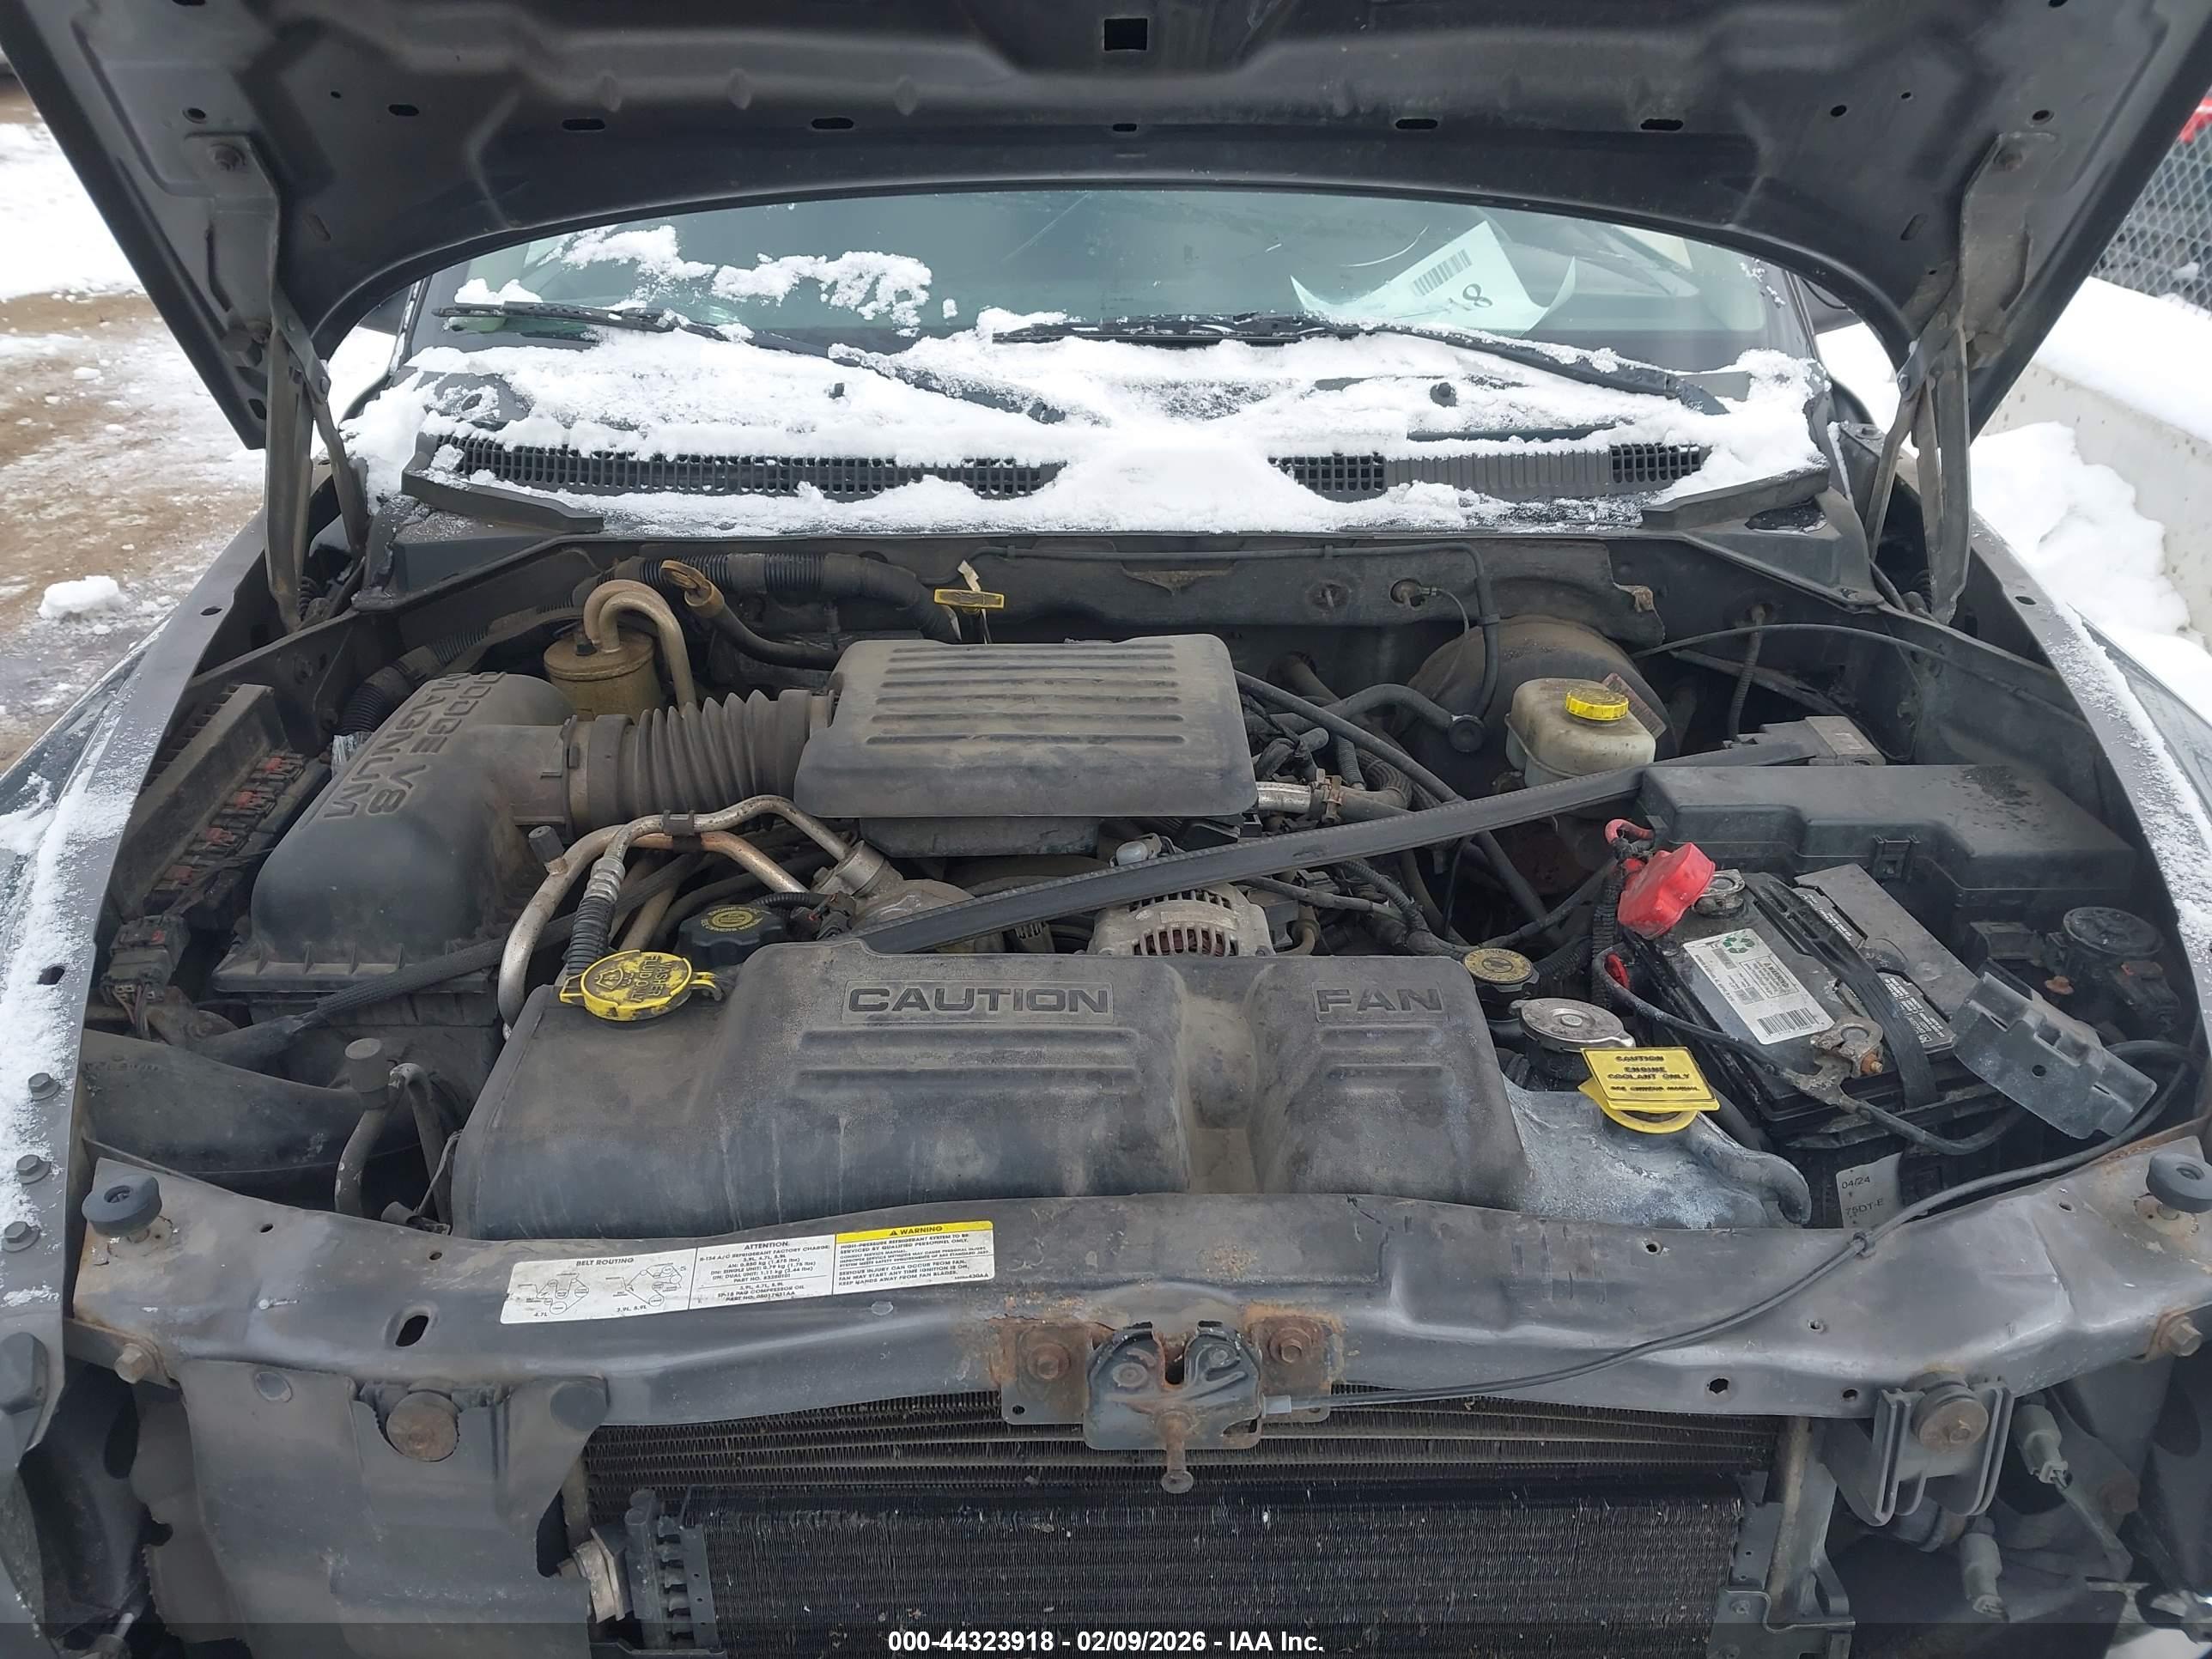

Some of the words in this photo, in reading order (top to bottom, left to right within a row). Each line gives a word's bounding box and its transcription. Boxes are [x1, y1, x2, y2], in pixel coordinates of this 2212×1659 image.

[409, 672, 506, 754] DODGE
[324, 672, 471, 817] MAGNUM
[366, 763, 427, 815] V8
[639, 955, 660, 981] FLUID
[648, 961, 675, 998] WASHER
[848, 988, 1109, 1014] CAUTION
[1318, 988, 1443, 1013] FAN
[1842, 1176, 1870, 1189] 04/24
[900, 1226, 943, 1235] WARNING
[744, 1241, 788, 1250] ATTENTION
